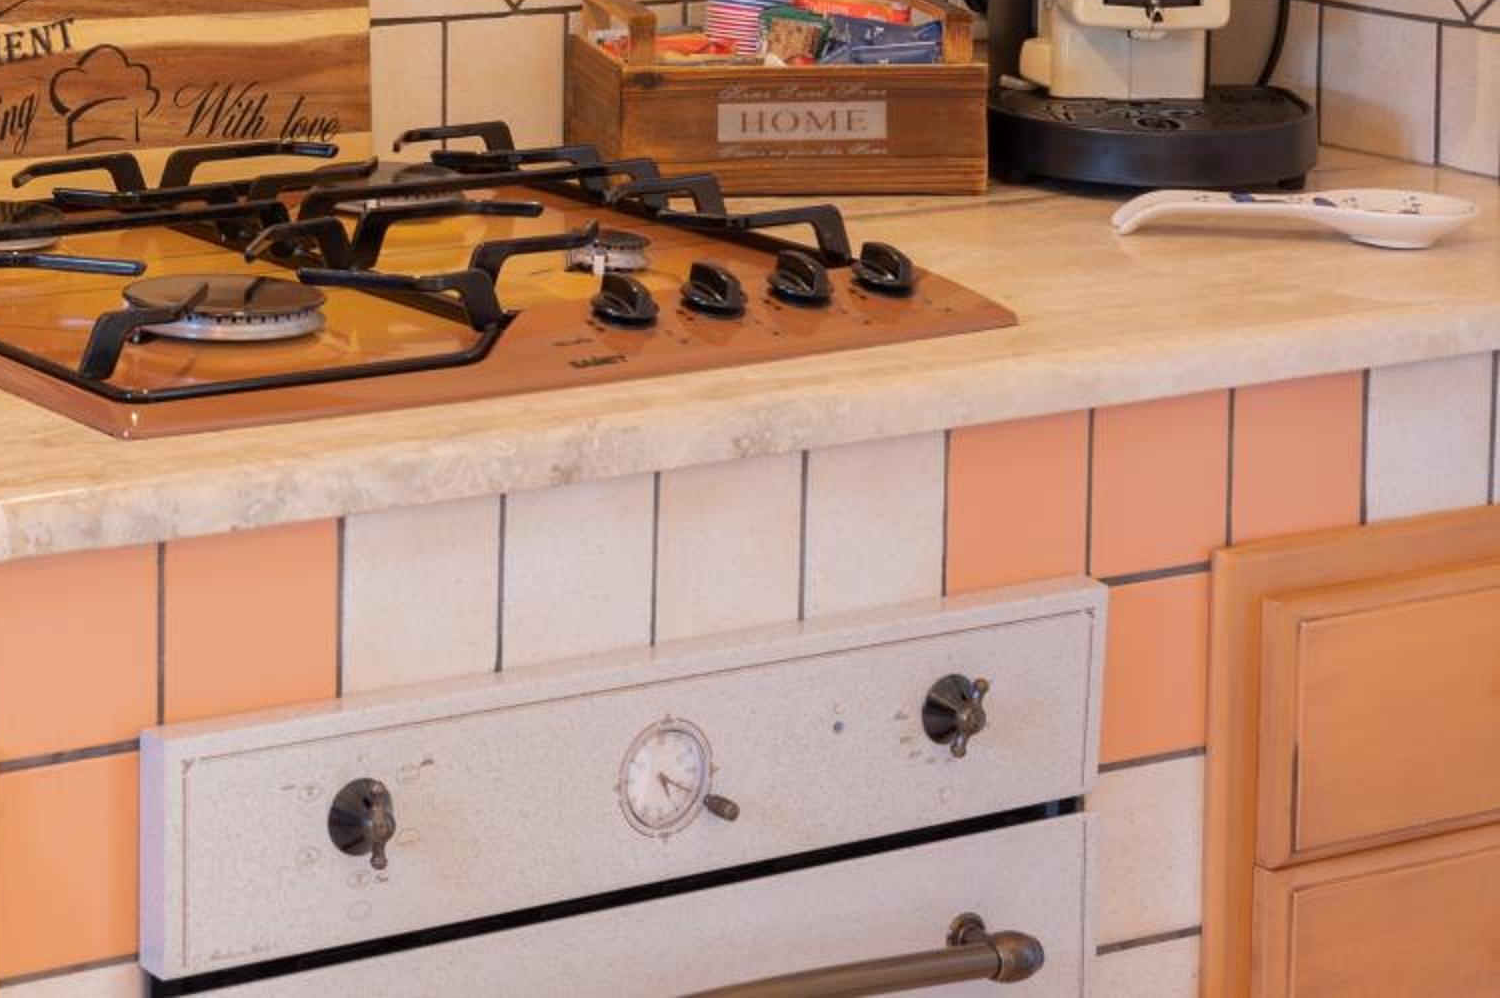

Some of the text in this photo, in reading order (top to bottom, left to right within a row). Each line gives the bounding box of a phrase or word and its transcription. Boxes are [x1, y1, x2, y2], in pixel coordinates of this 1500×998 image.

[173, 80, 270, 139] With
[279, 94, 341, 142] love
[739, 108, 869, 134] HOME
